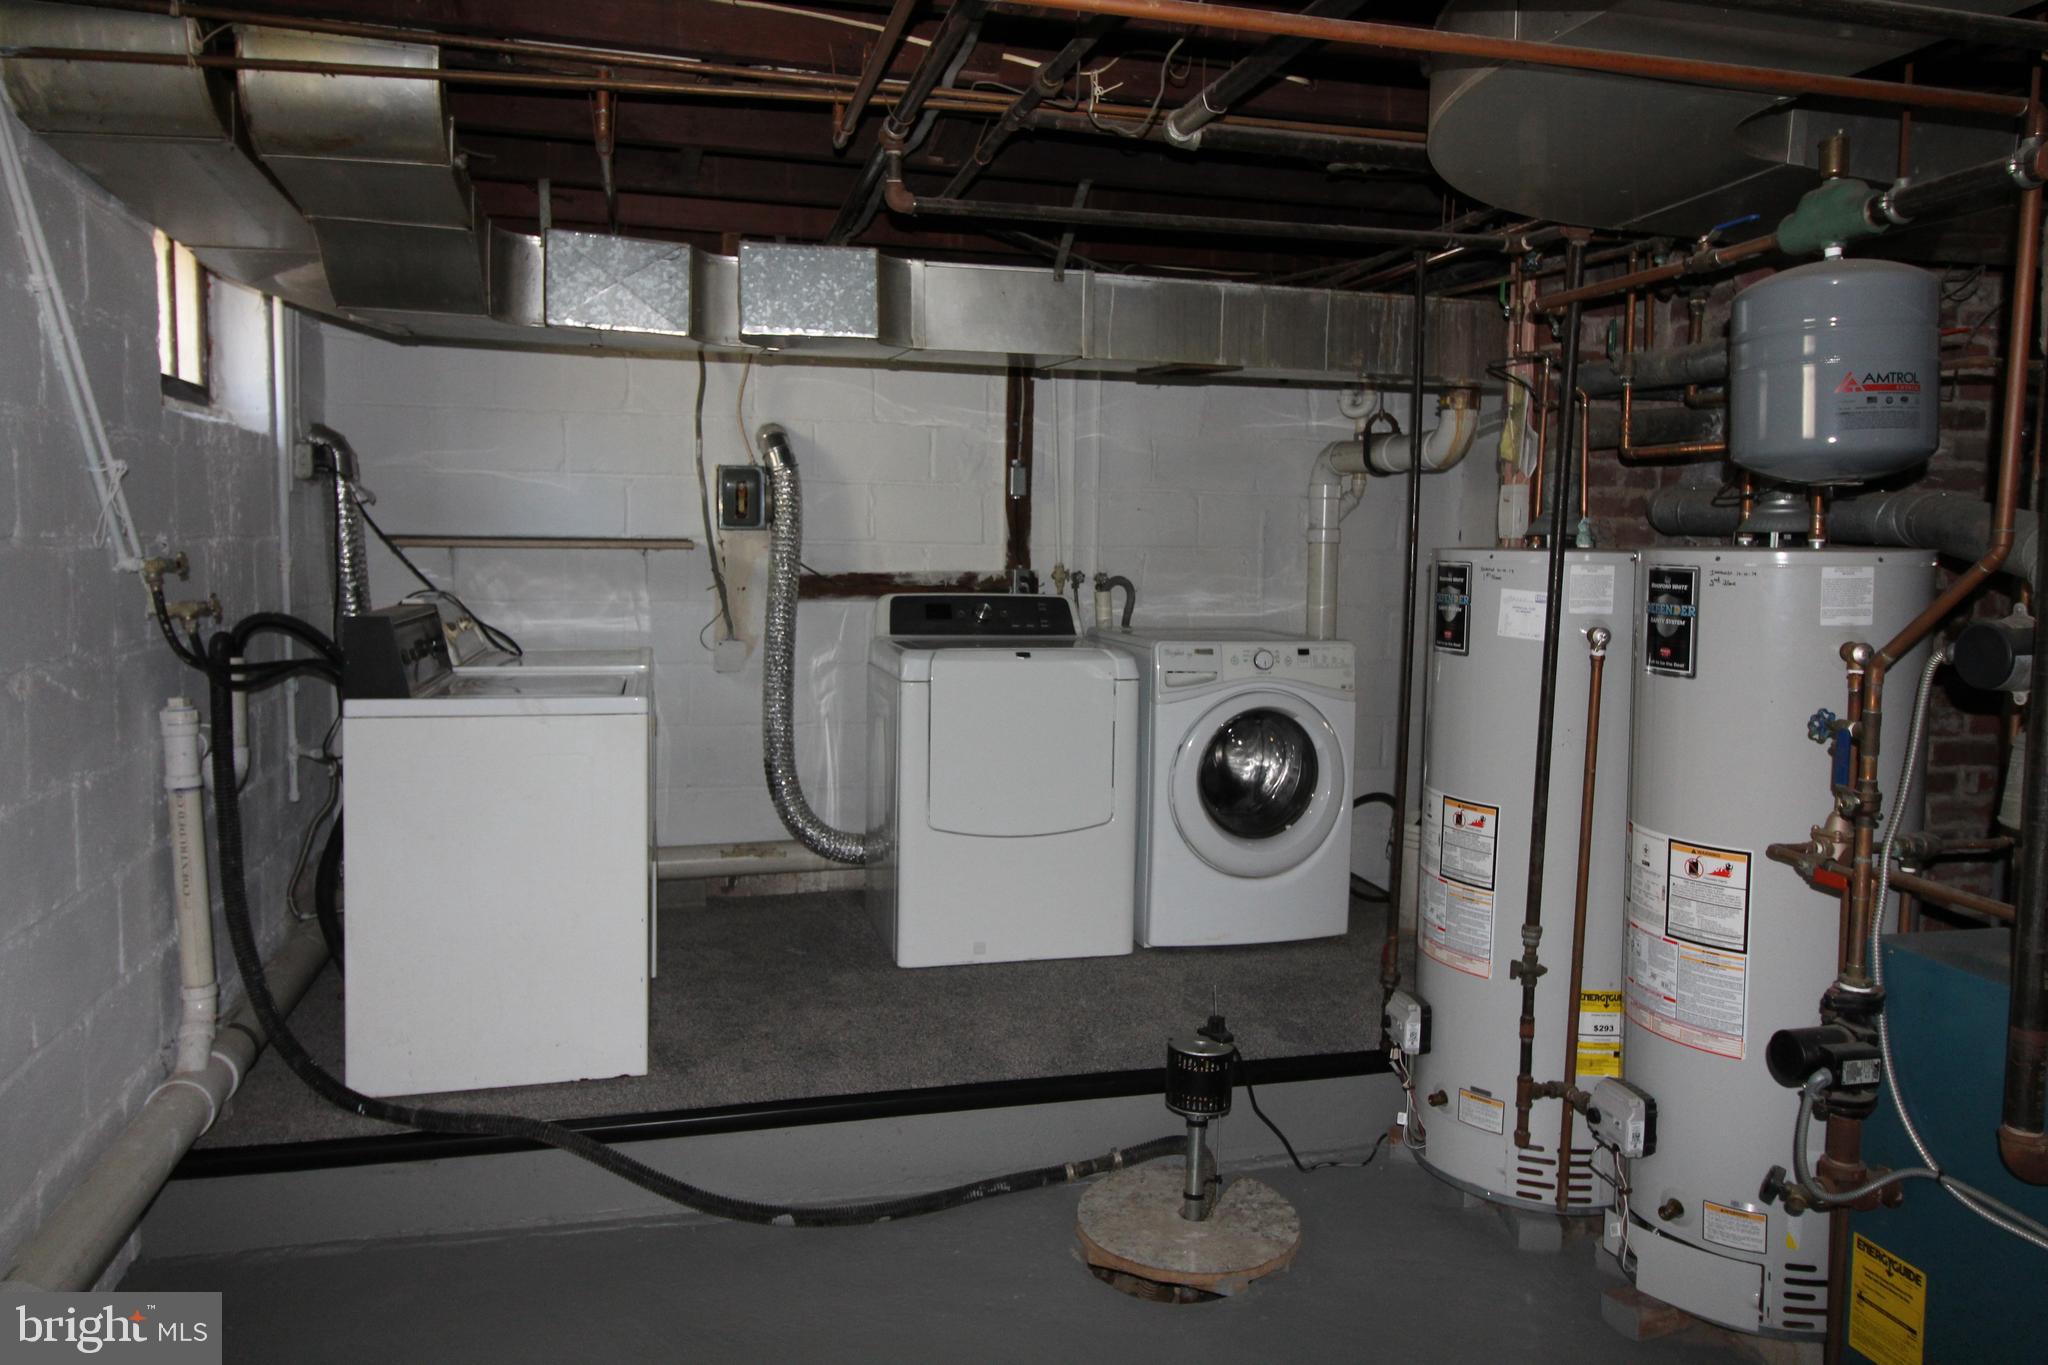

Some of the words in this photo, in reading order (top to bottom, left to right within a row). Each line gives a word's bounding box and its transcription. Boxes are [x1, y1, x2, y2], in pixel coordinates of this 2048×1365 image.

[1863, 372, 1919, 384] AMTROL
[1647, 602, 1696, 618] DEFENDER
[1593, 1024, 1615, 1032] $293
[1856, 1237, 1923, 1288] ENERGYGUIDE
